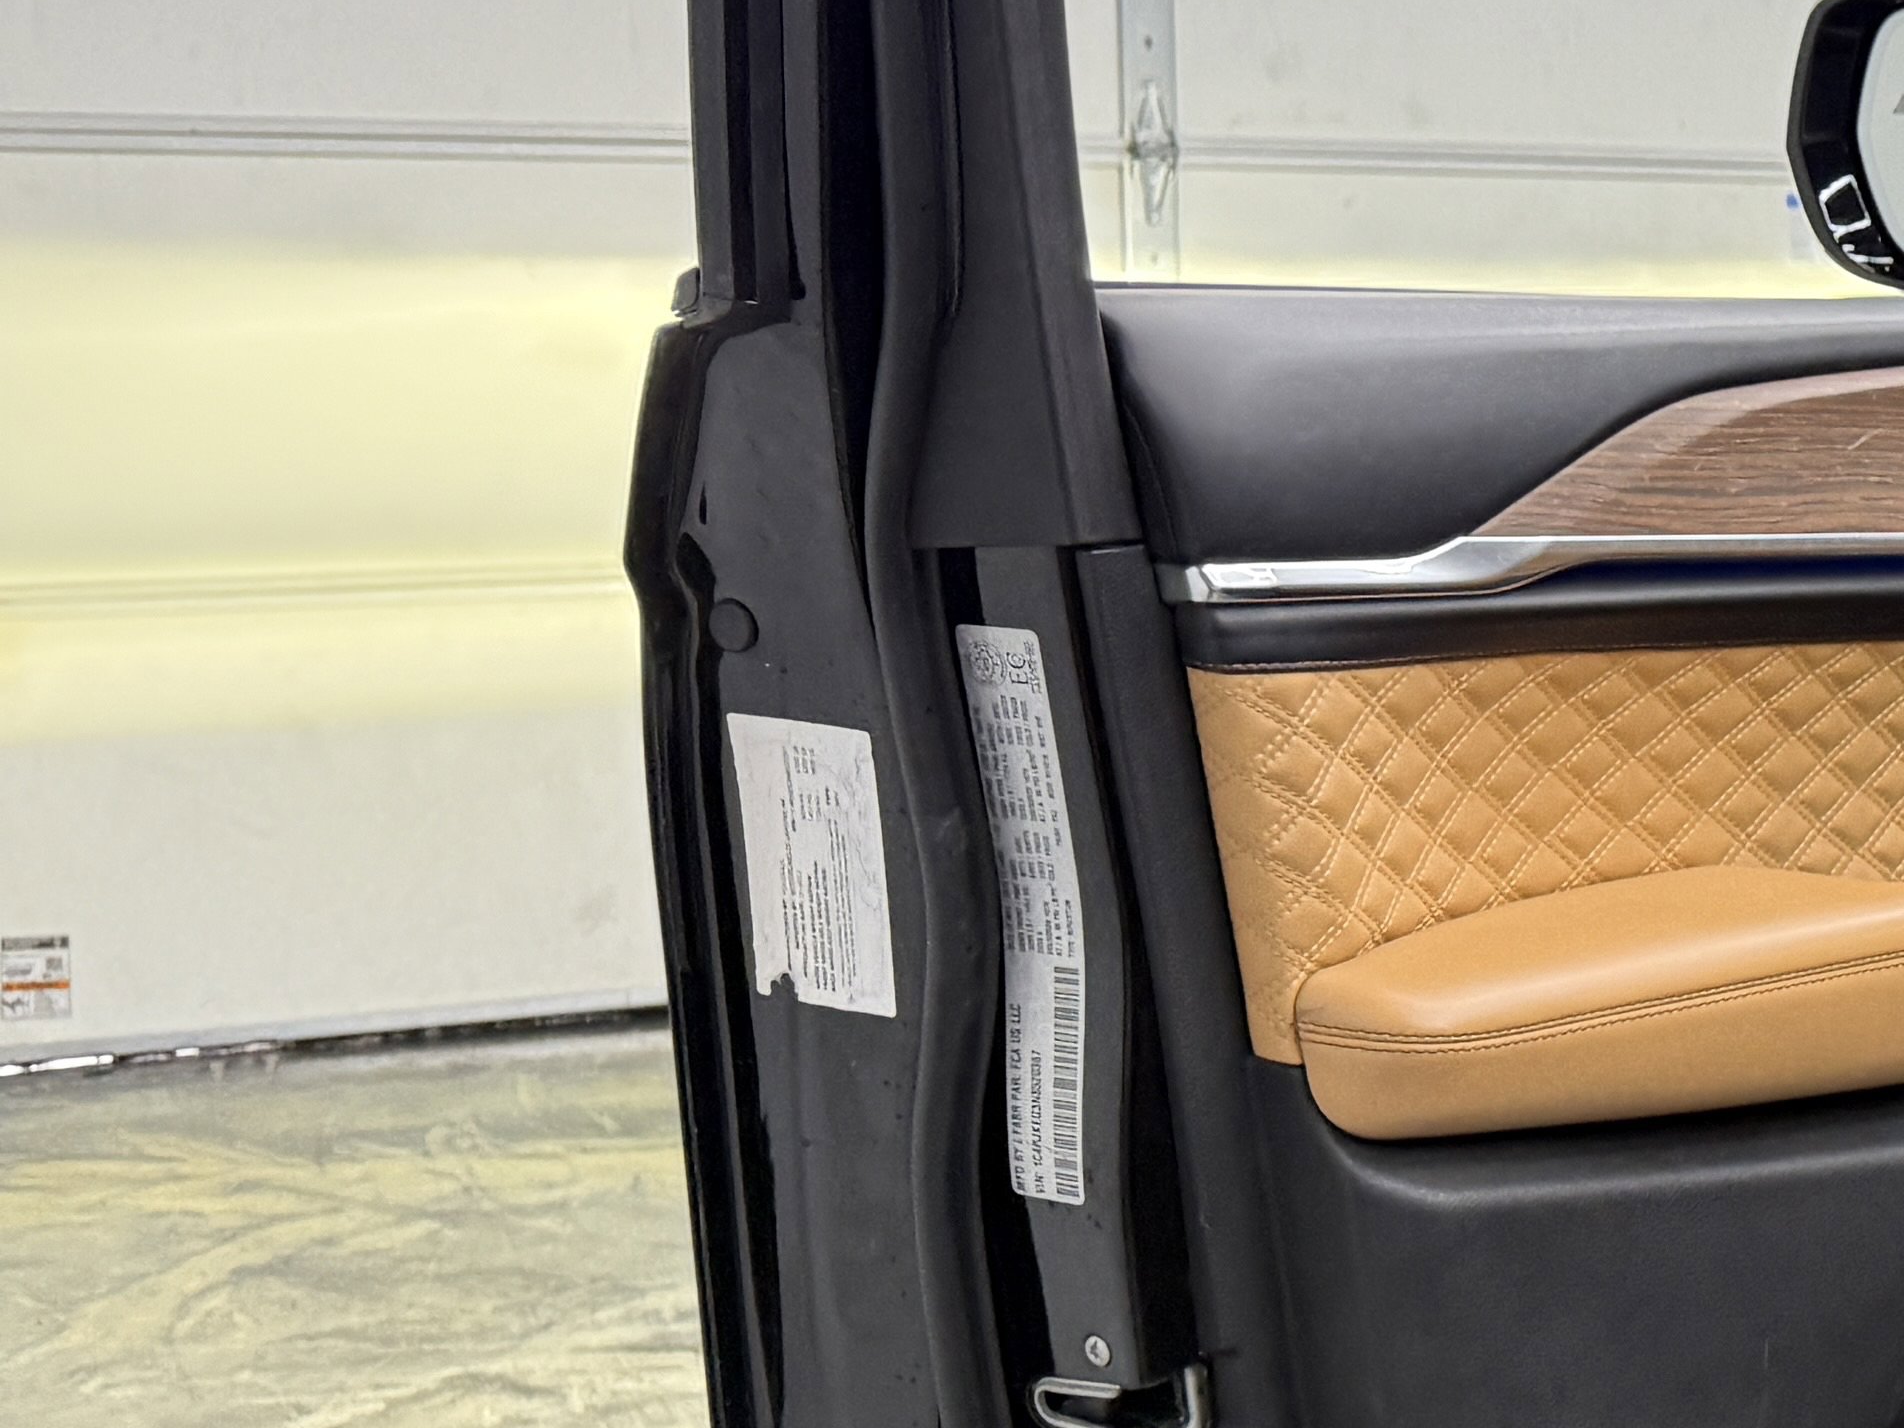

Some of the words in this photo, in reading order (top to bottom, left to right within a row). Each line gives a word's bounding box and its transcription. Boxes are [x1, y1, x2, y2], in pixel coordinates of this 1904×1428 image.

[1010, 1003, 1021, 1024] LLC
[1010, 1028, 1021, 1043] US
[1010, 1048, 1021, 1070] FCA
